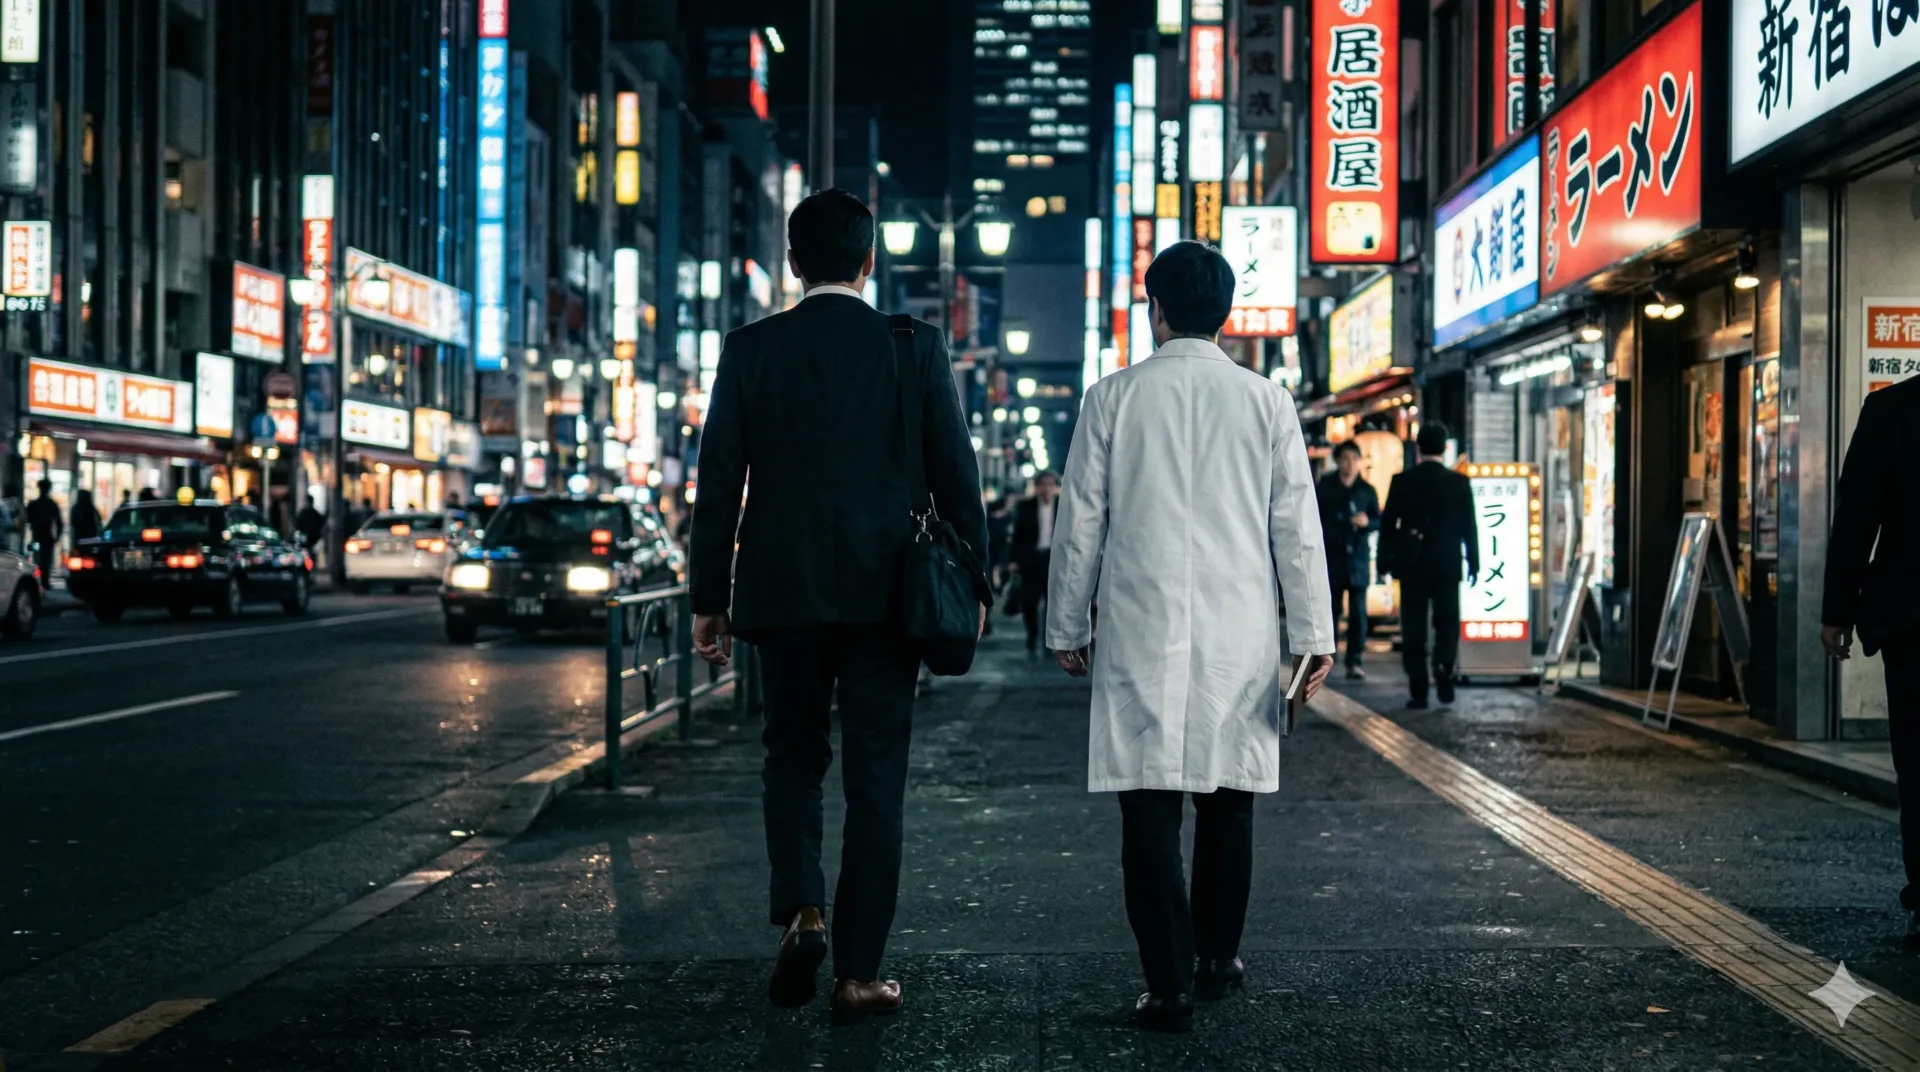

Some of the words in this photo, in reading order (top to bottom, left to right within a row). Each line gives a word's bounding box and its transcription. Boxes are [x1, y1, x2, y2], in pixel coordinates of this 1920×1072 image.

[1327, 0, 1385, 191] 居酒屋
[1566, 71, 1694, 247] ラーメン
[1241, 217, 1260, 297] ラーメン
[1482, 504, 1507, 612] ラーメン
